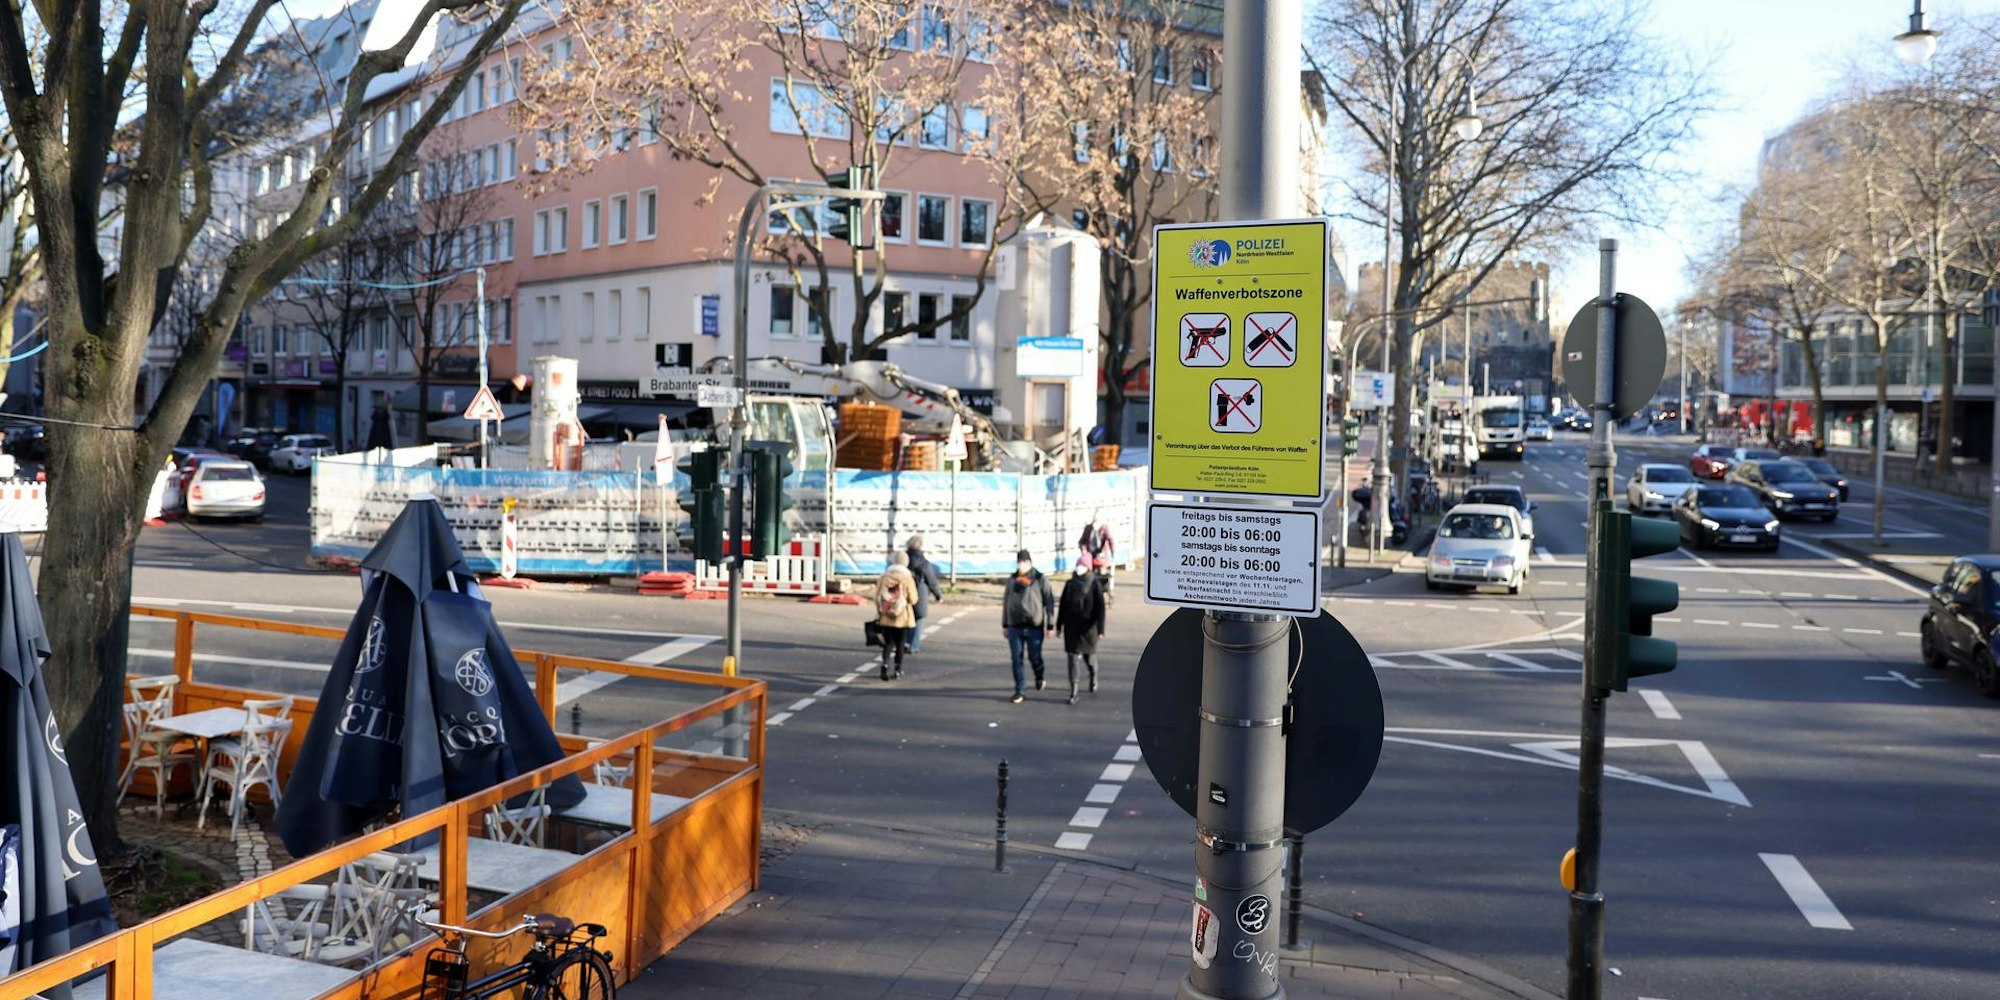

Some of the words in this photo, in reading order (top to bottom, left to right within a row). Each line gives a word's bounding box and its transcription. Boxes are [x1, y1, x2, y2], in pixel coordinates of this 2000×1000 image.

[1236, 238, 1285, 250] POLIZEI
[1175, 287, 1303, 300] Waffenverbotszone
[1181, 511, 1216, 523] freitags
[1218, 513, 1233, 522] bis
[1235, 515, 1281, 526] samstags
[1181, 525, 1216, 538] 20:00
[1220, 528, 1240, 540] bis
[1244, 529, 1281, 542] 06:00
[1181, 542, 1222, 553] samstags
[1224, 543, 1238, 552] bis
[1239, 545, 1281, 556] sonntags
[1181, 554, 1216, 568] 20:00
[1220, 557, 1240, 570] bis
[1244, 559, 1281, 573] 06:00
[1164, 568, 1181, 576] sowie
[1183, 569, 1225, 579] entsprechend
[1239, 573, 1304, 585] Wochenfeiertagen,
[1186, 577, 1238, 587] Karnevalstagen
[1253, 582, 1273, 590] 11.11.
[1177, 584, 1231, 594] Weiberfastnacht
[1243, 589, 1289, 599] einschließlich
[1184, 592, 1238, 603] Aschermittwoch
[1238, 597, 1257, 605] jeden
[1258, 598, 1280, 606] Jahres
